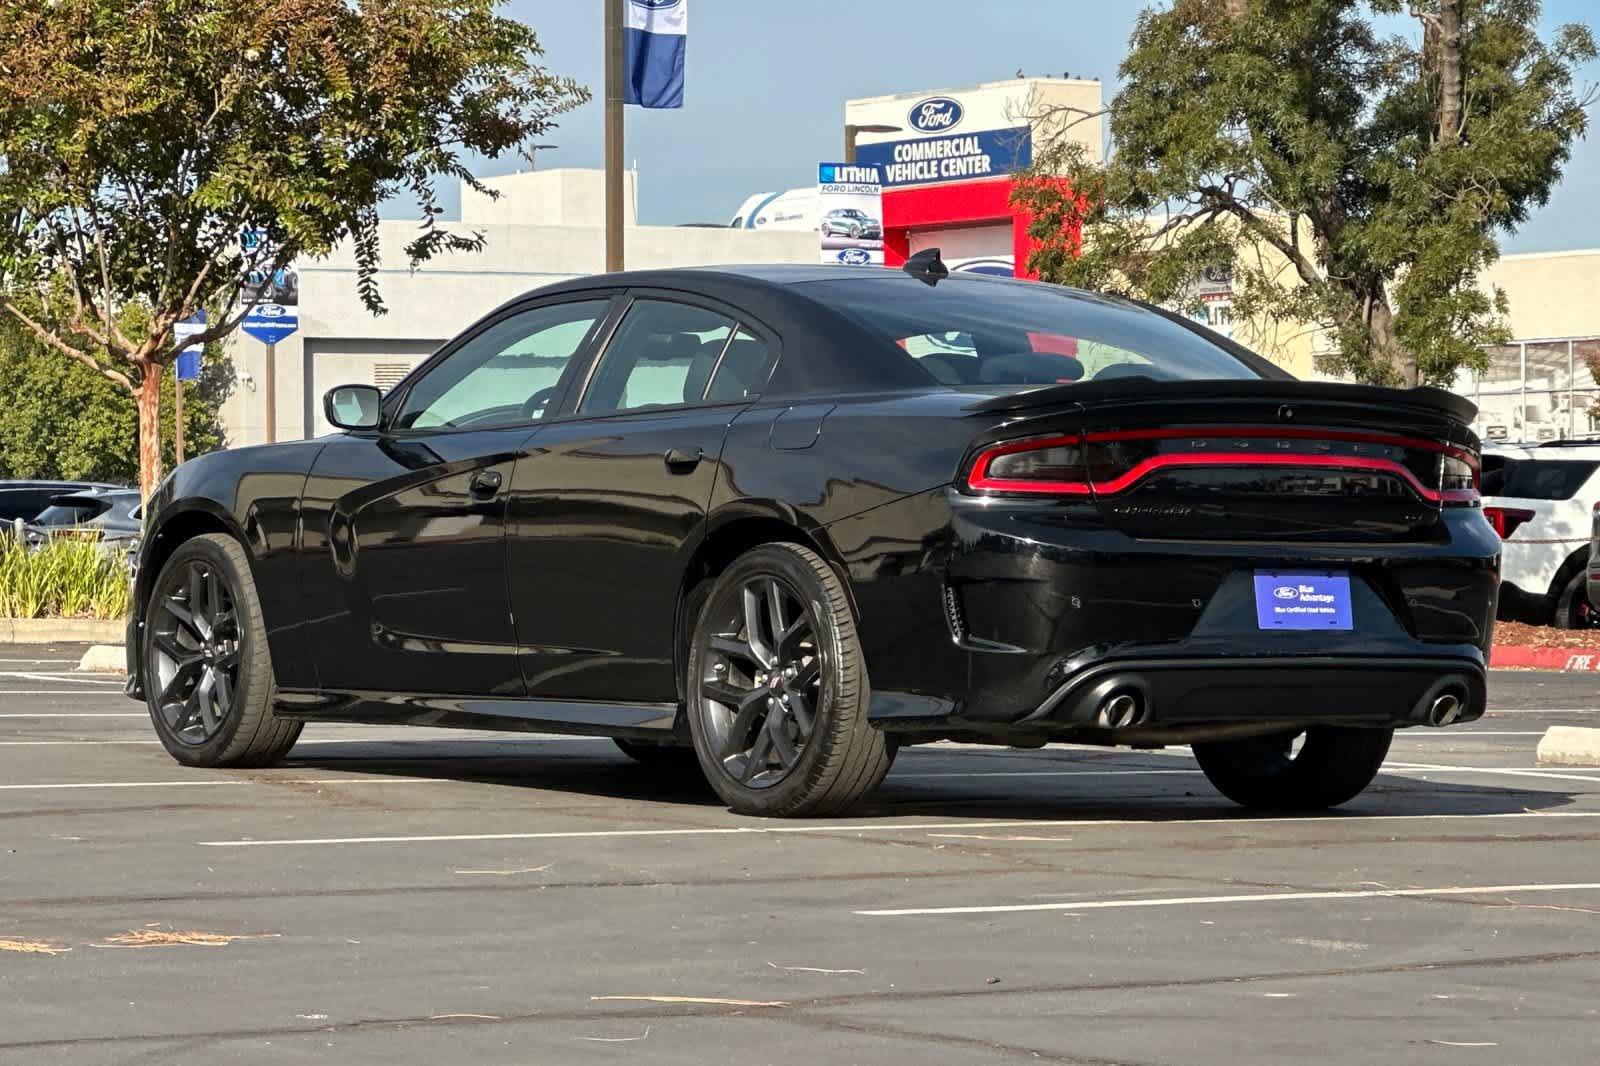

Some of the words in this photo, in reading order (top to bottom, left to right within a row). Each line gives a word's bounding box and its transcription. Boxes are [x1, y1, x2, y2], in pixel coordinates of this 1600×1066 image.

[918, 102, 954, 128] Ford
[894, 136, 982, 162] COMMERCIAL
[834, 166, 880, 183] LITHIA
[885, 159, 939, 183] VEHICLE
[941, 154, 991, 178] CENTER
[822, 184, 846, 193] FORD
[847, 184, 880, 193] LINCOLN
[843, 250, 867, 263] Ford
[1300, 594, 1334, 603] Advantage
[1565, 654, 1595, 670] FIRE
